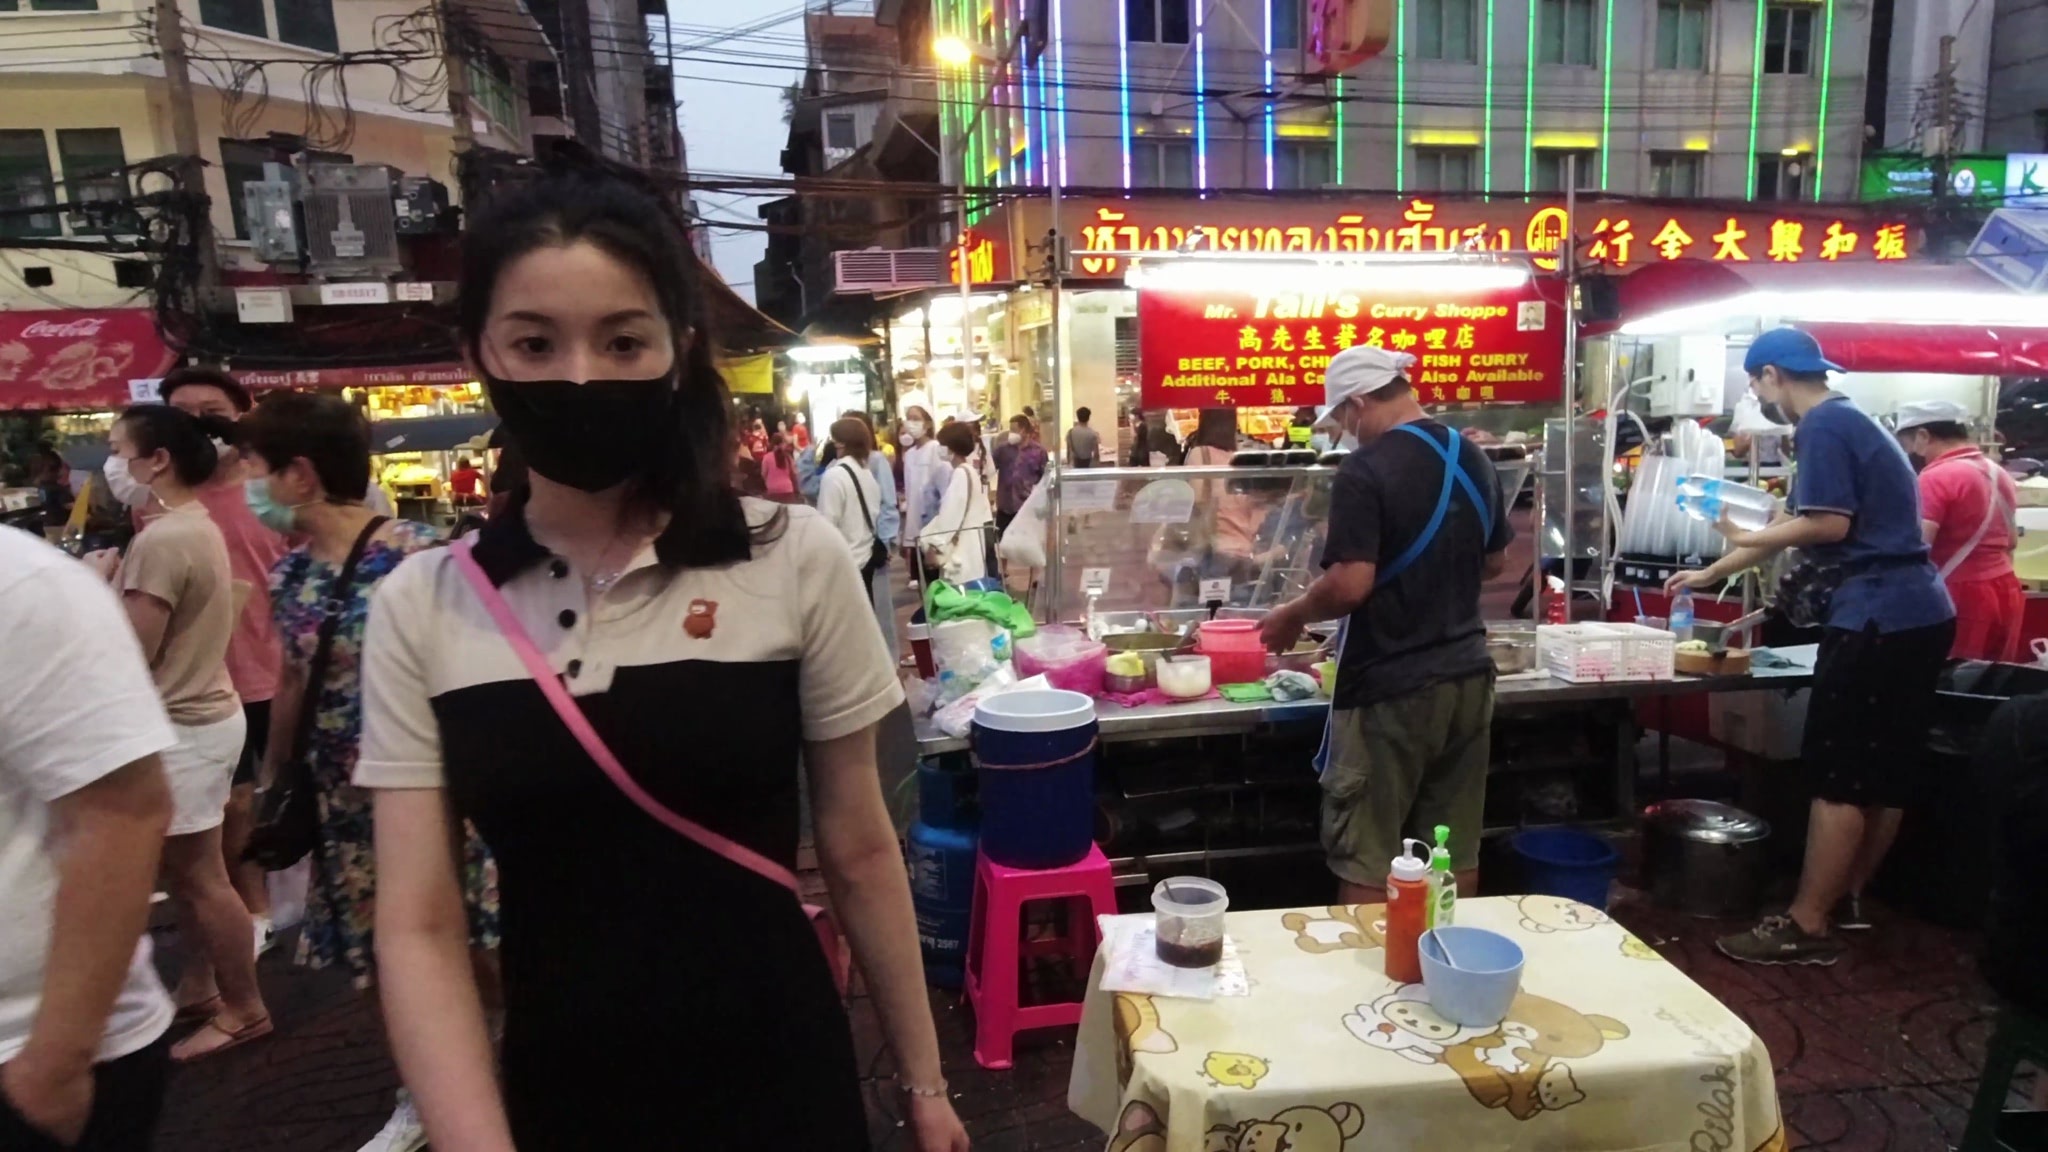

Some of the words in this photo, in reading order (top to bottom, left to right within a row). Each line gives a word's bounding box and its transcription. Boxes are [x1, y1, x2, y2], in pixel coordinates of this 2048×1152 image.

[1204, 303, 1239, 319] Mr.
[1370, 303, 1428, 321] Curry
[1434, 304, 1508, 320] Shoppe
[1178, 357, 1230, 372] BEEF,
[1236, 356, 1295, 371] PORK,
[1422, 354, 1462, 368] FISH
[1469, 353, 1529, 367] CURRY
[1161, 373, 1257, 388] Additional
[1265, 372, 1297, 386] Ala
[1420, 370, 1459, 384] Also
[1466, 369, 1544, 382] Available
